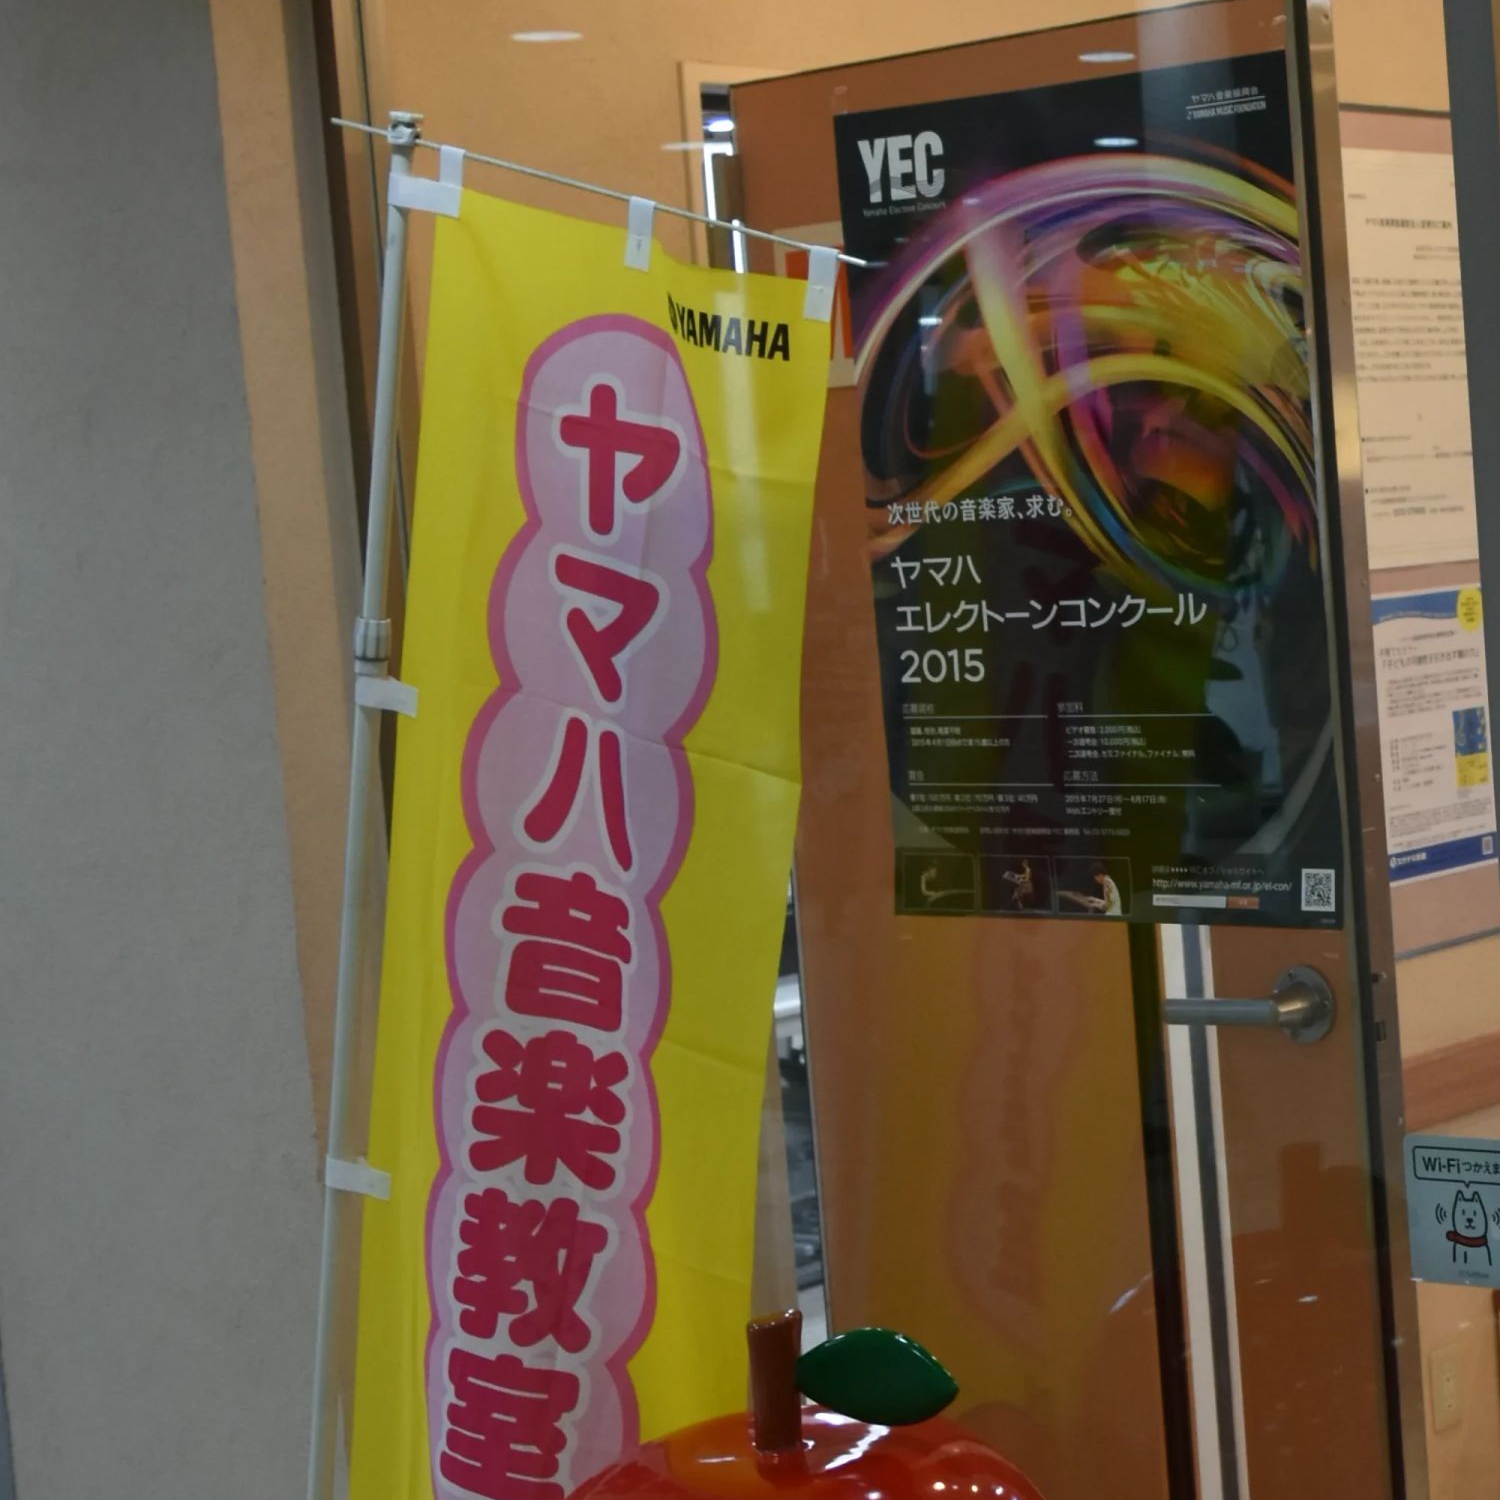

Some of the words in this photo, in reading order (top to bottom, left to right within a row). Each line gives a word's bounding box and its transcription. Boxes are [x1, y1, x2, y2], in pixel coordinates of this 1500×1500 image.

[857, 131, 945, 204] YEC
[676, 303, 790, 362] YAMAHA
[887, 494, 1074, 526] 次世代の音楽家、求む。
[891, 555, 981, 590] ヤマハ
[895, 593, 1208, 633] エレクトーンコンクール
[900, 648, 985, 684] 2015
[1422, 1155, 1461, 1174] Wi-Fi
